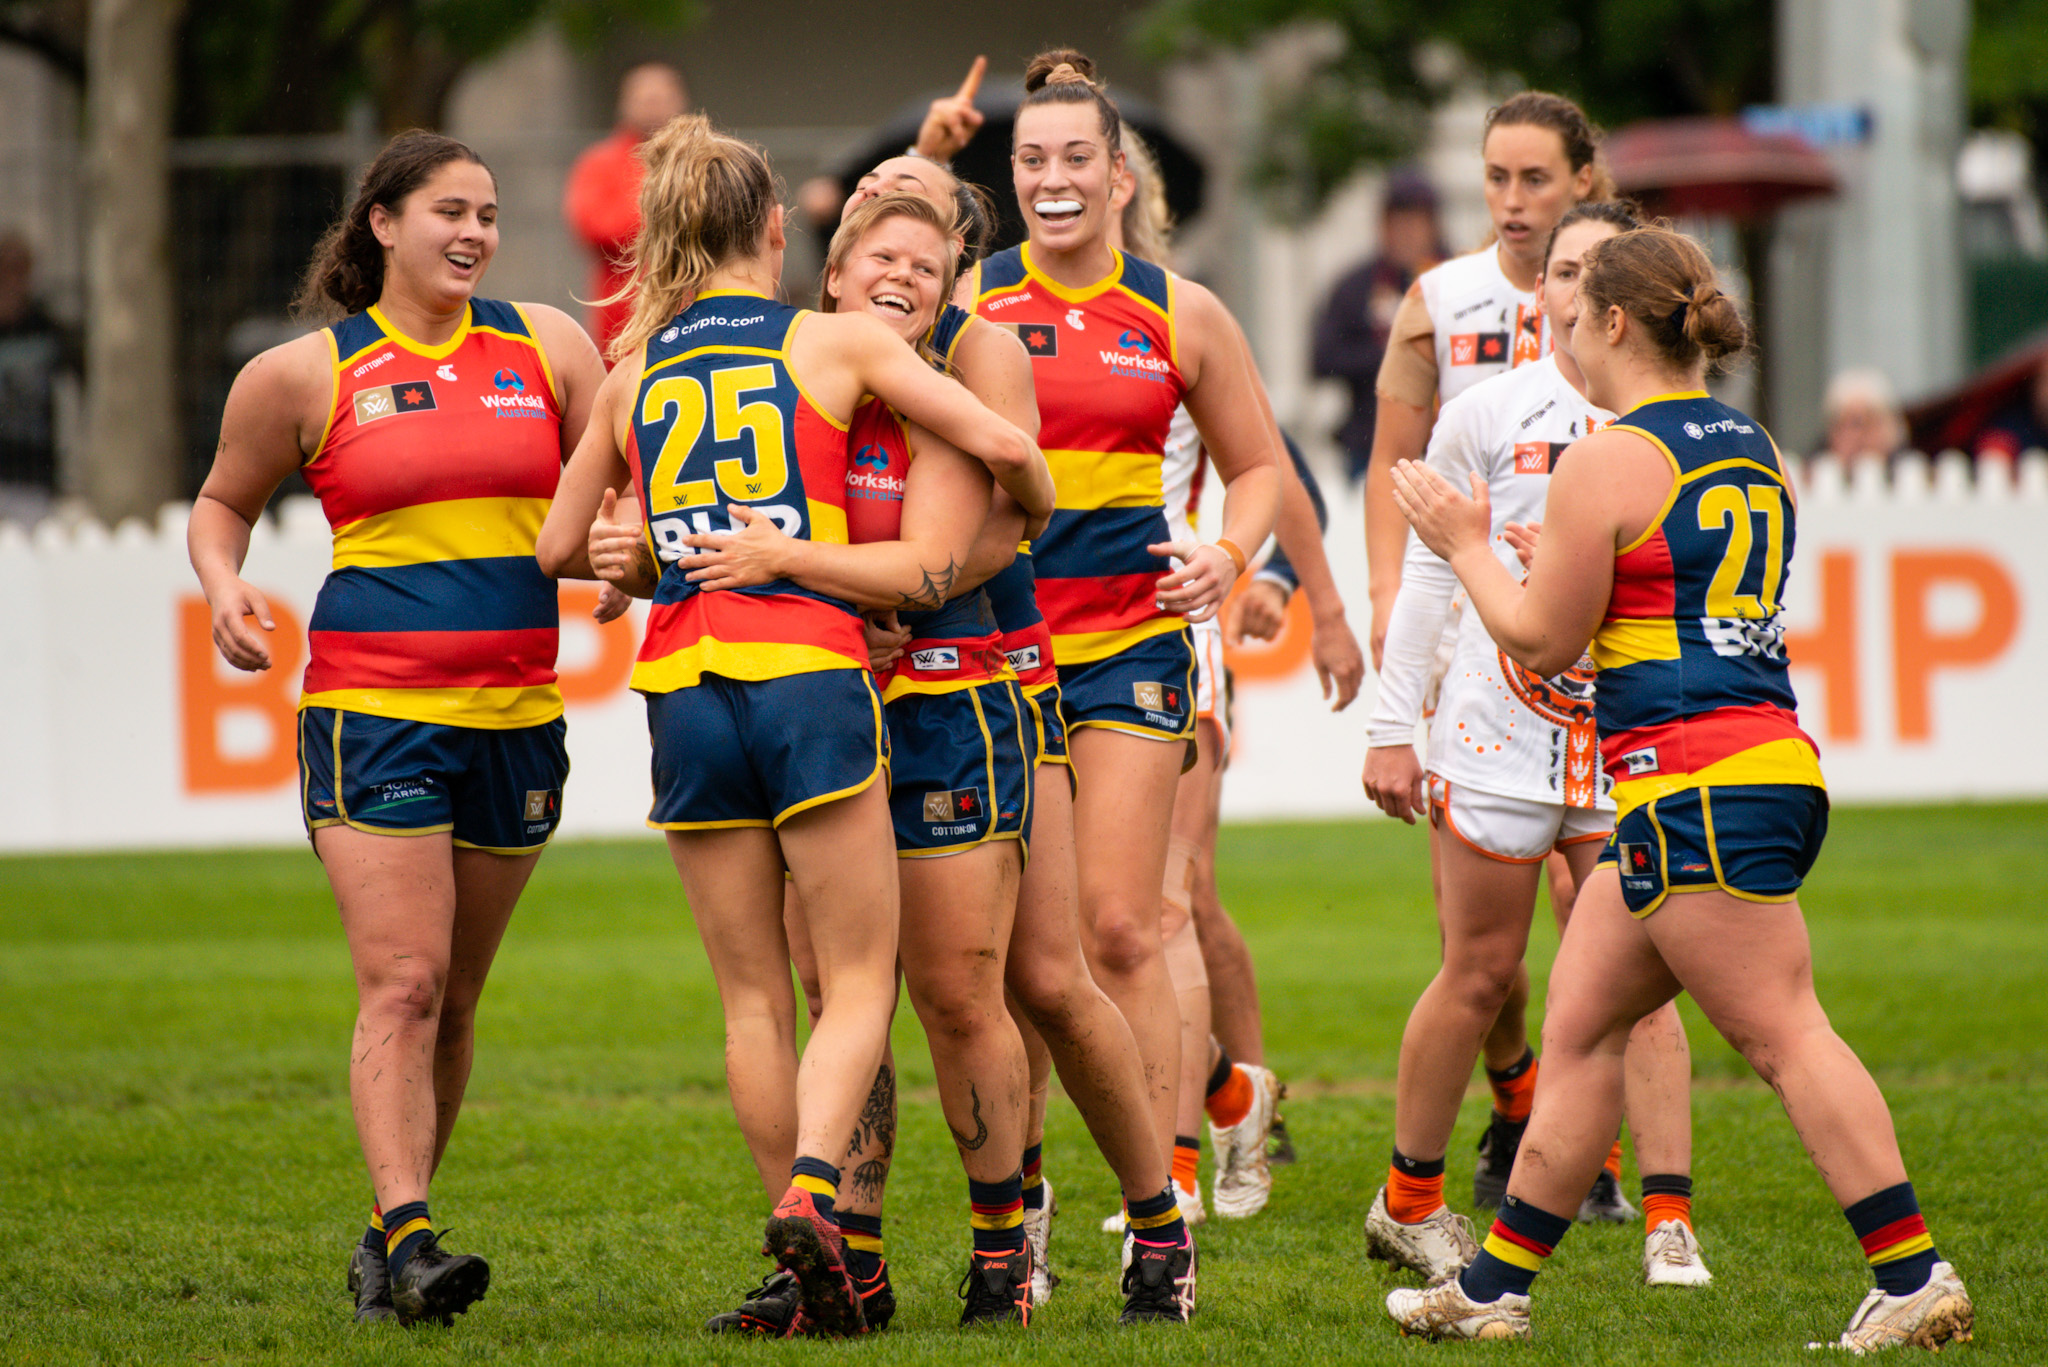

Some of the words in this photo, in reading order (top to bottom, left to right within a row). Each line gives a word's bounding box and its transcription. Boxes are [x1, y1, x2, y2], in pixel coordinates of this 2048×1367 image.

[988, 291, 1033, 312] COTTON:ON
[681, 315, 765, 335] crypto.com
[353, 351, 396, 378] COTTON:ON
[1110, 365, 1166, 383] Australia
[480, 394, 546, 409] Workskil
[496, 407, 547, 420] Australia
[642, 363, 789, 516] 25
[1697, 484, 1784, 618] 27
[1784, 549, 2021, 742] HP
[383, 787, 426, 802] FARMS
[932, 823, 977, 836] COTTON:ON
